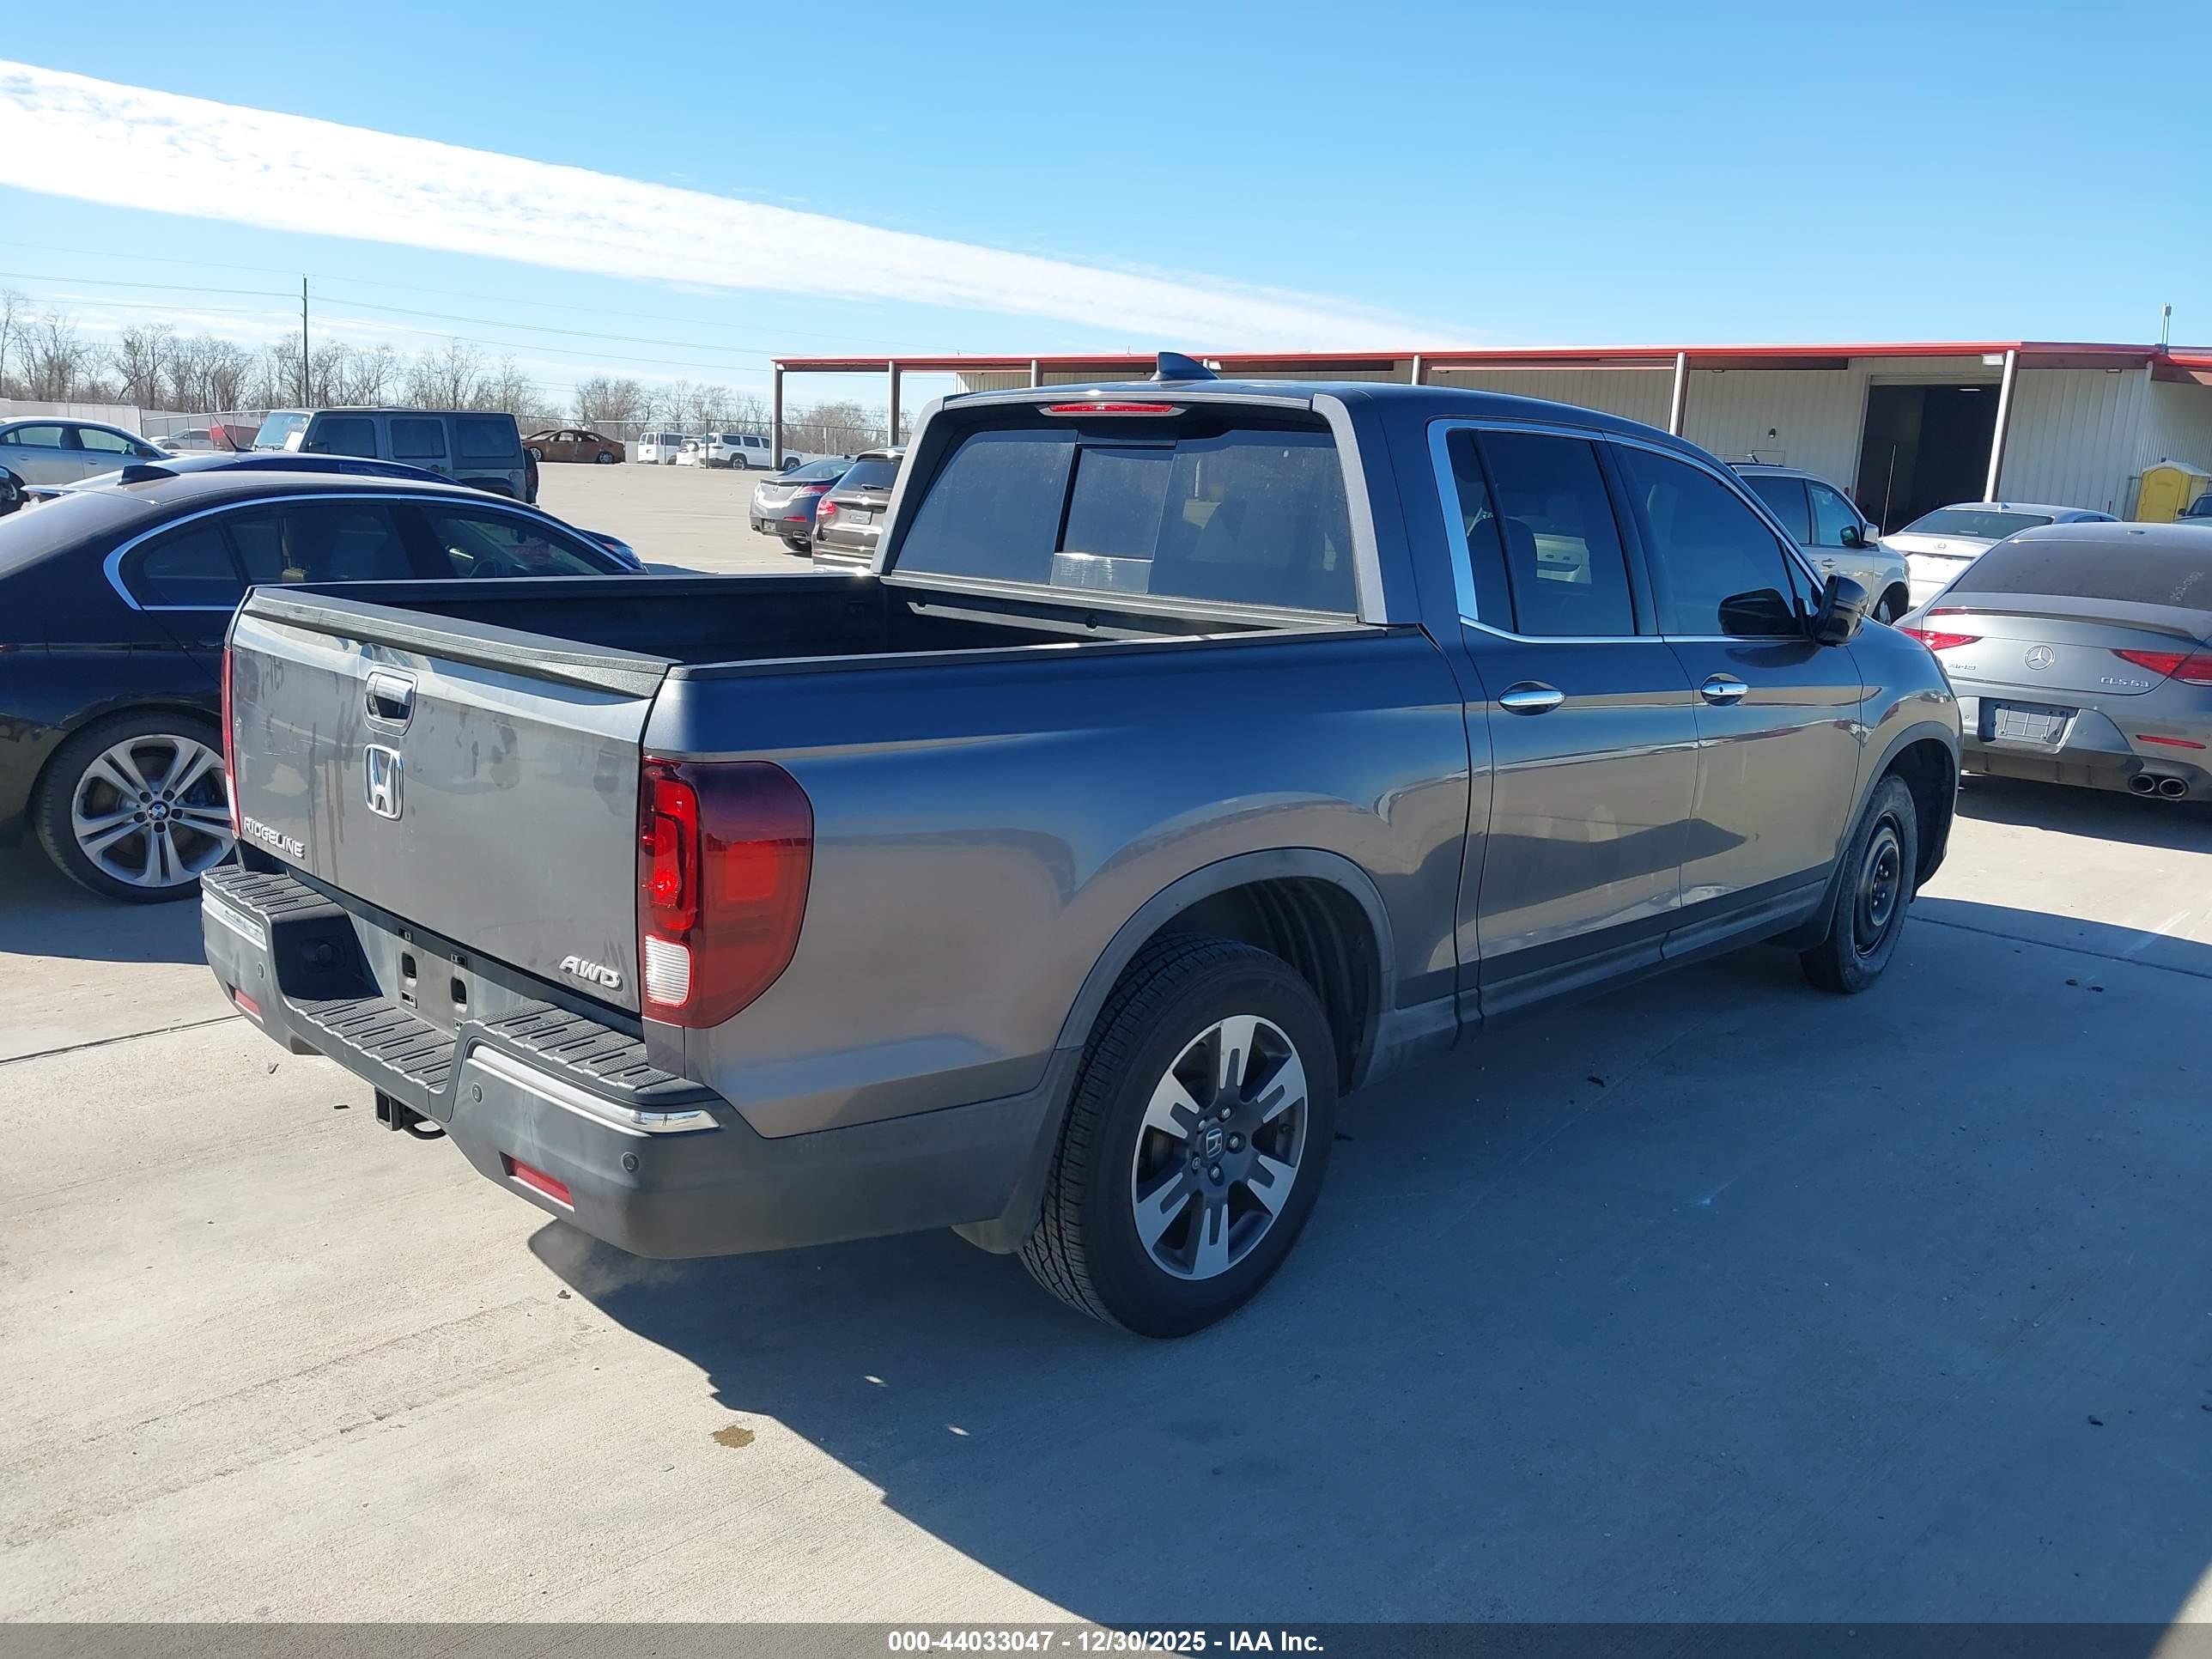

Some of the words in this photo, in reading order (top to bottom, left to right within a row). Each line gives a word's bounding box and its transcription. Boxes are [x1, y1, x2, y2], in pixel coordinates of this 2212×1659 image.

[2100, 677, 2128, 685] CLS
[244, 817, 306, 860] RIDGELINE
[558, 955, 622, 989] AWD
